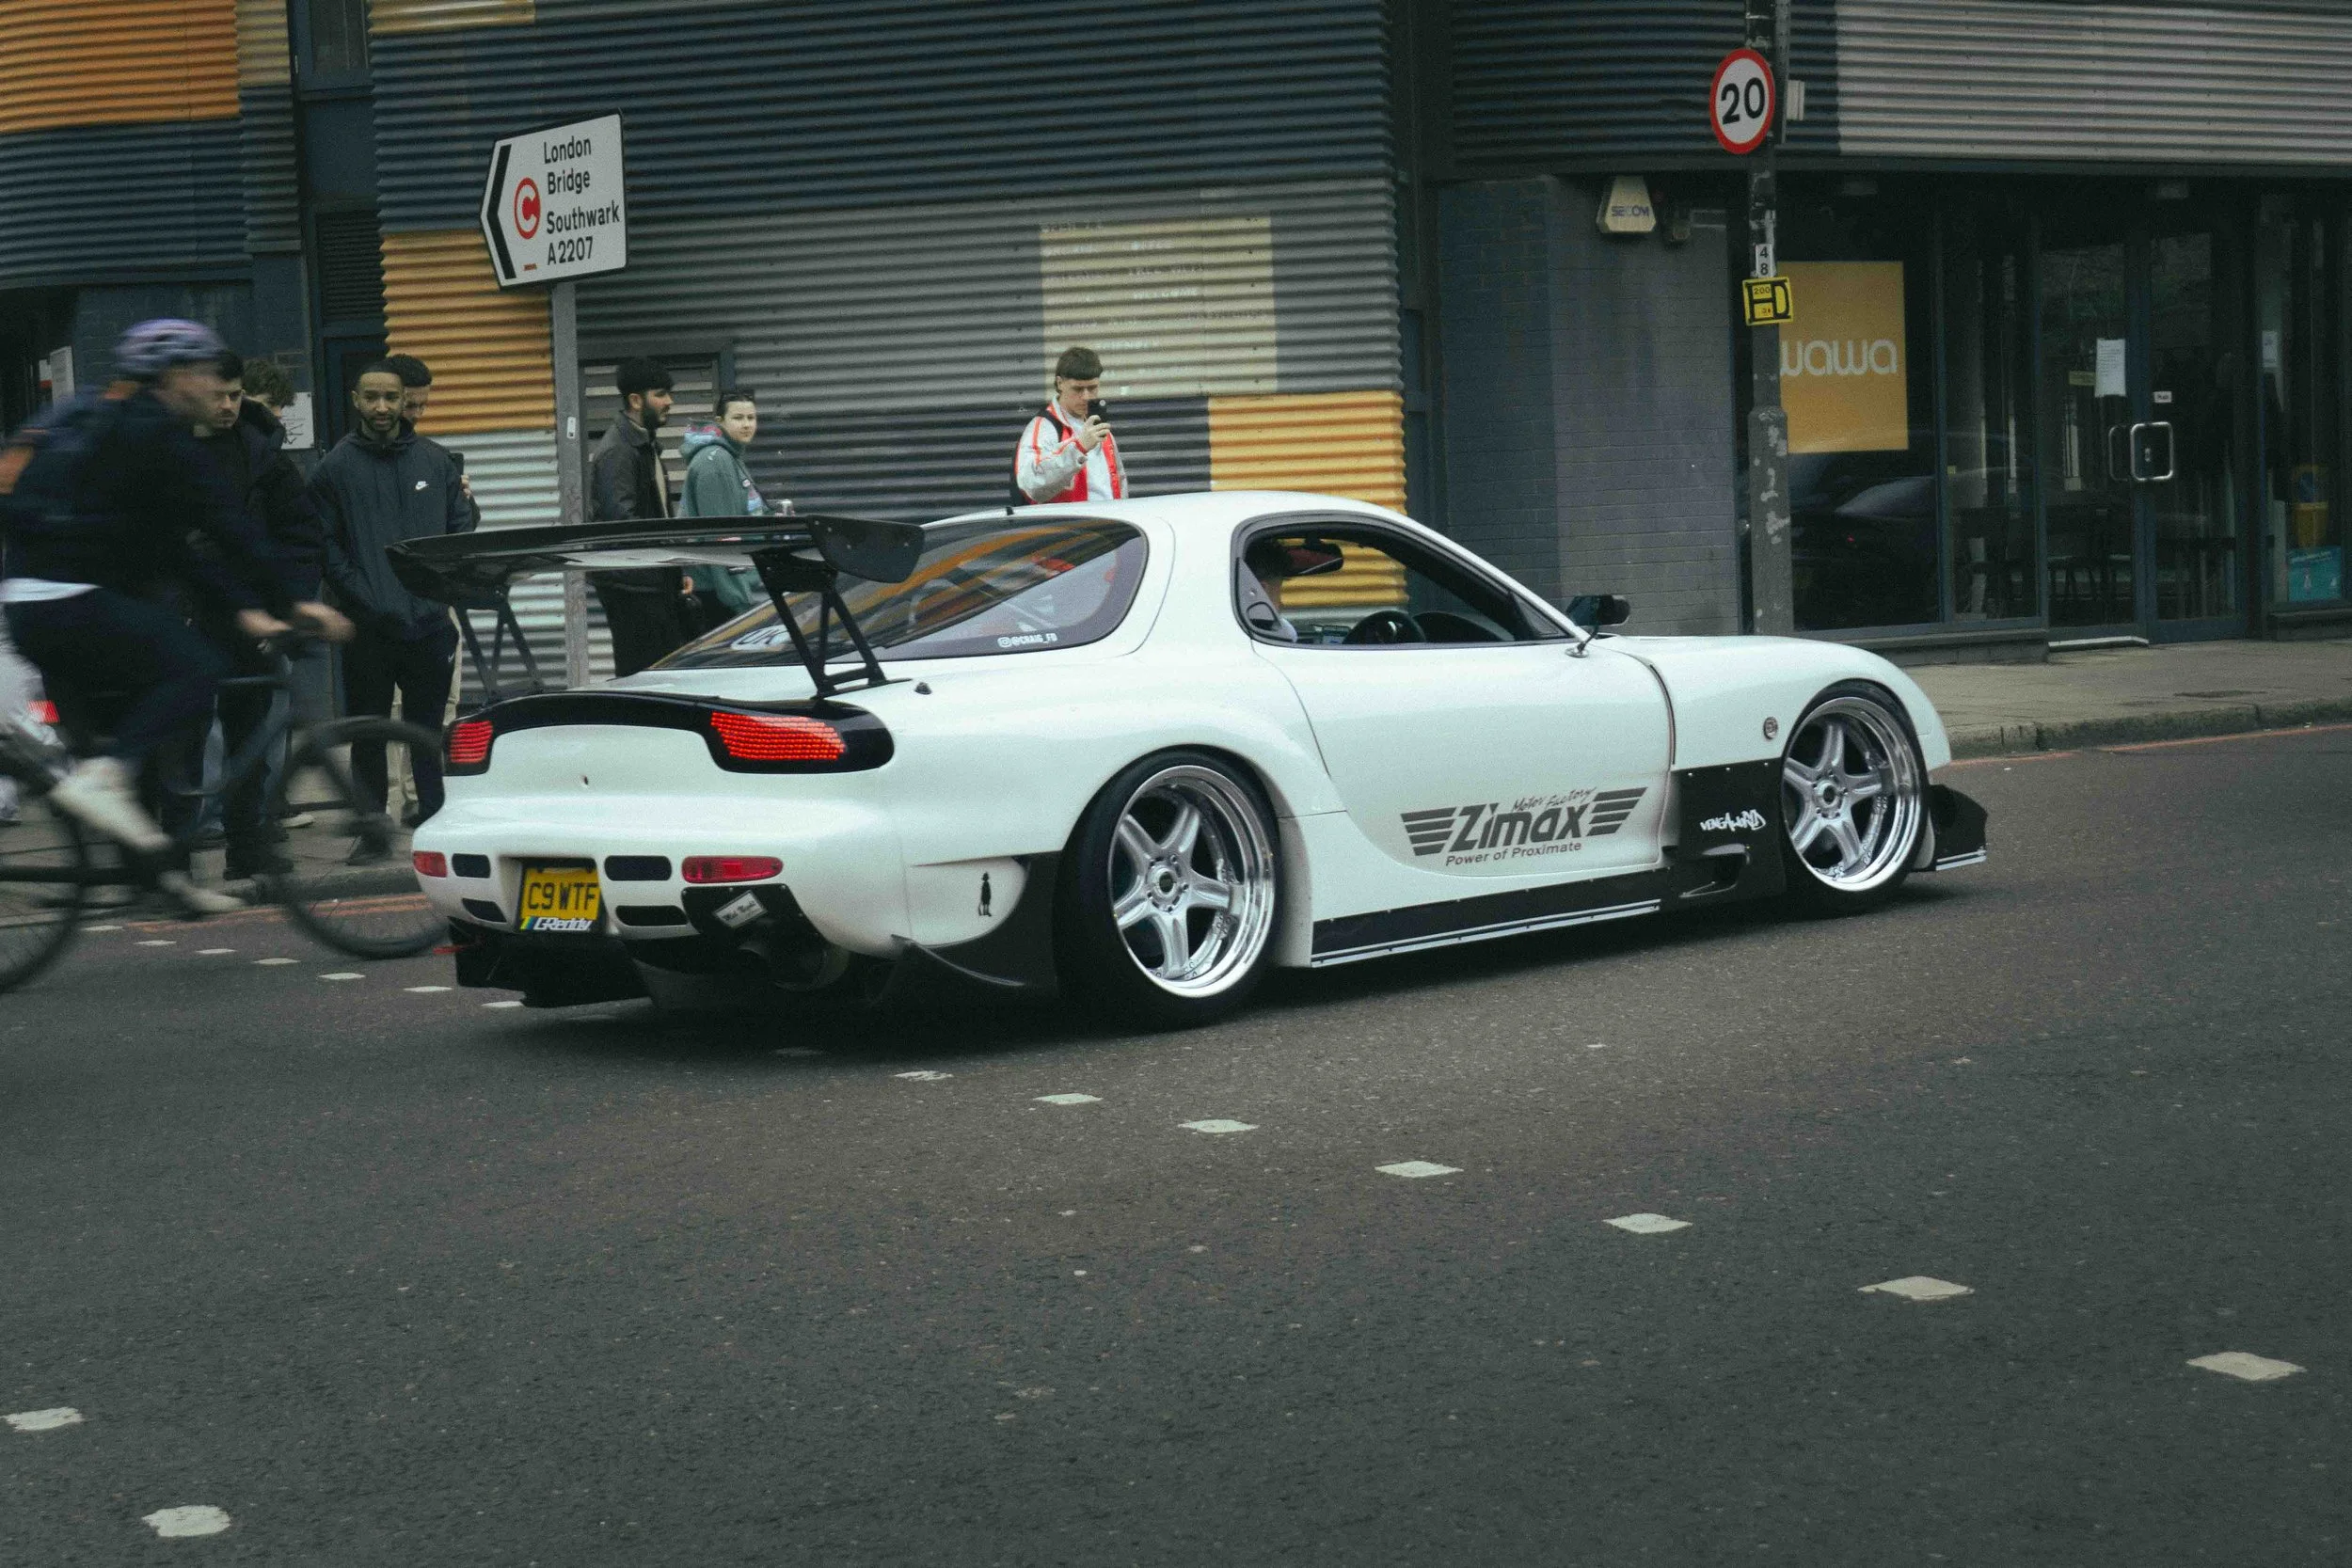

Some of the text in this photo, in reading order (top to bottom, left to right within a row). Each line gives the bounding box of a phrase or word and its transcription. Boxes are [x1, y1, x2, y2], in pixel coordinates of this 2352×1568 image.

[1721, 77, 1765, 124] 20
[544, 135, 592, 164] London
[548, 168, 591, 195] Bridge
[546, 200, 620, 234] Southwark
[548, 236, 594, 265] A2207
[1449, 801, 1591, 852] Zimax
[1445, 841, 1582, 866] Power of Proximate
[528, 882, 599, 910] C9 WTF
